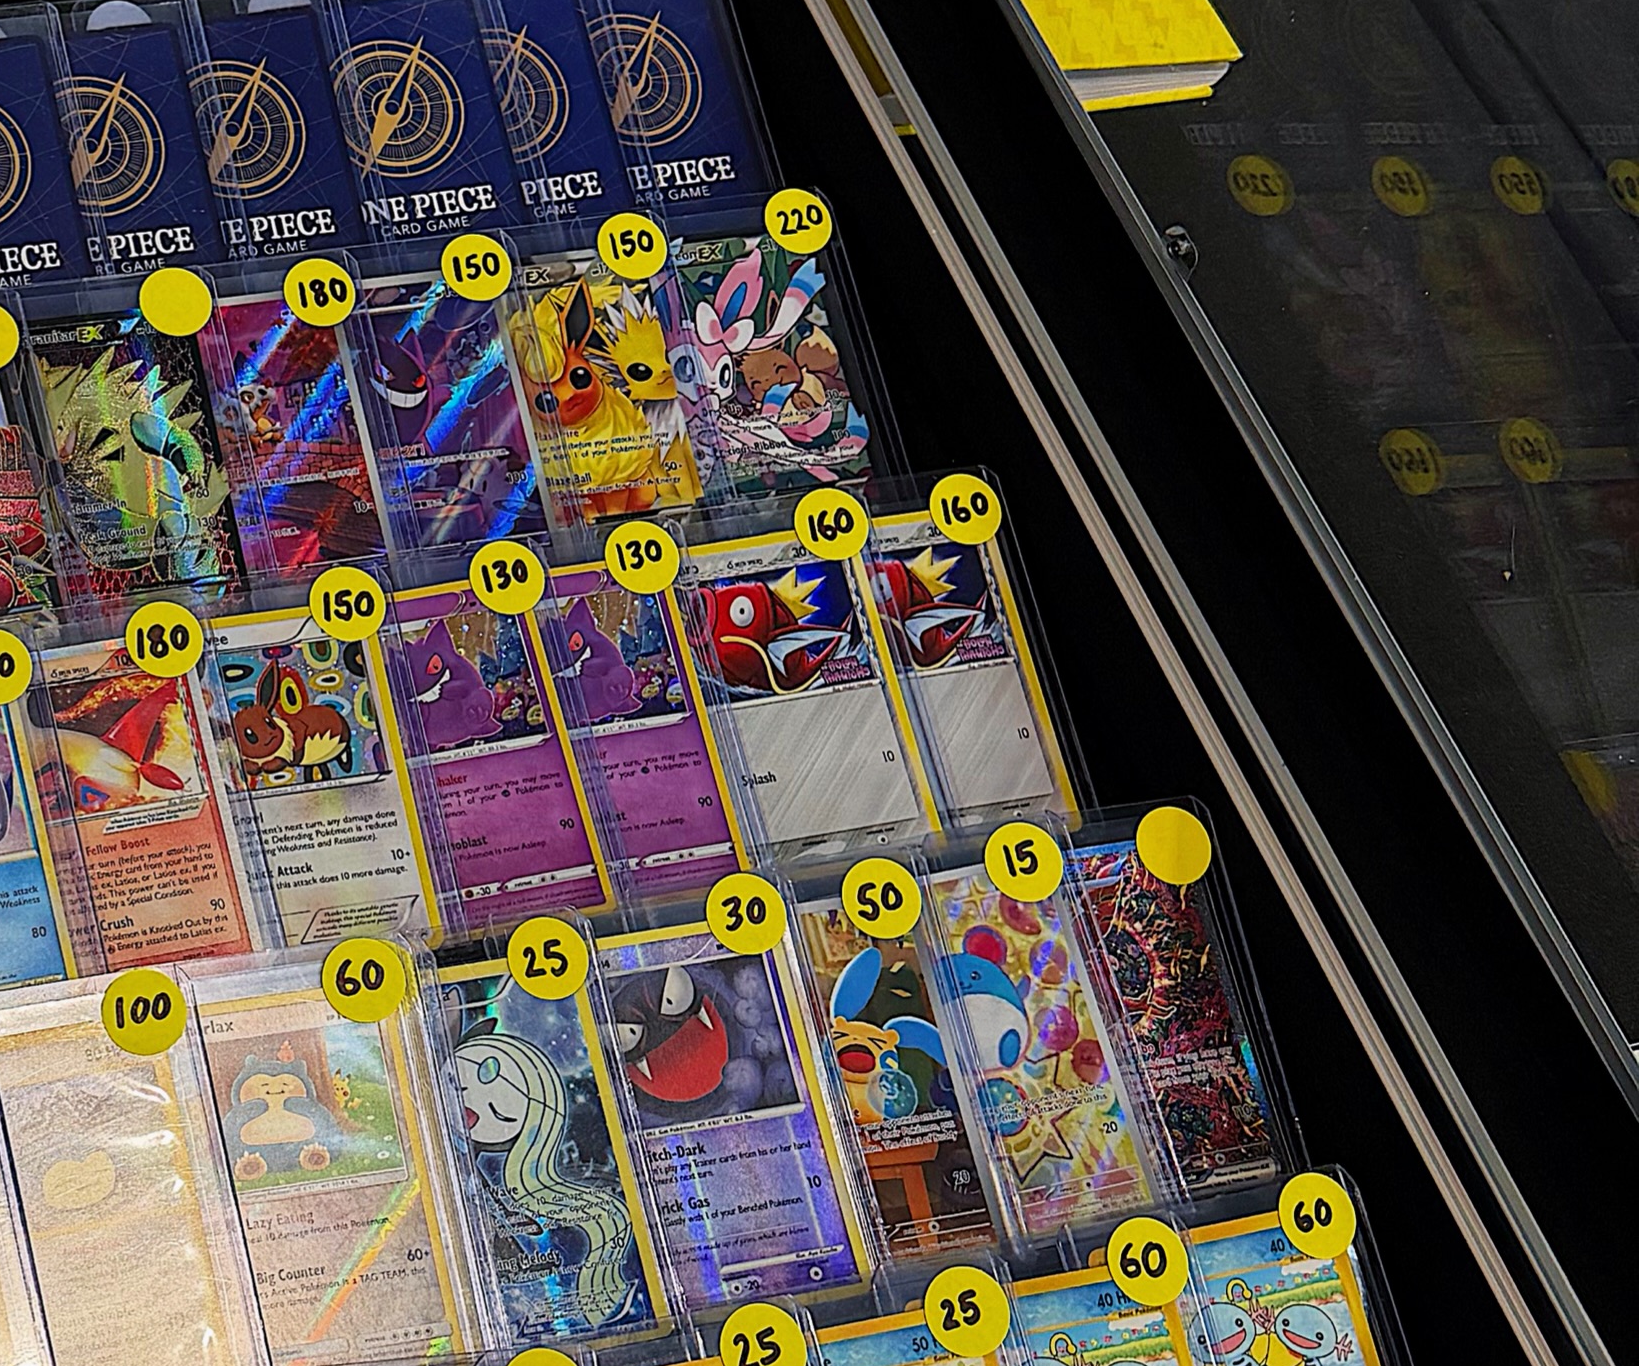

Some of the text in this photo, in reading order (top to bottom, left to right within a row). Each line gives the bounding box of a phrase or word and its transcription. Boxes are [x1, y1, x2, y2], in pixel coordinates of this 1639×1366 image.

[522, 171, 602, 205] PIECE
[653, 157, 736, 193] PIECE
[416, 185, 496, 222] PIECE
[777, 206, 823, 234] 220
[249, 209, 335, 244] PIECE
[112, 227, 194, 264] PIECE
[609, 231, 653, 258] 150
[453, 253, 499, 282] 150
[299, 278, 346, 307] 180
[809, 511, 853, 540] 160
[942, 493, 988, 525] 160
[616, 541, 662, 570] 130
[482, 561, 528, 593] 130
[324, 591, 374, 620] 150
[137, 626, 188, 659] 180
[277, 862, 313, 878] Attack
[1004, 840, 1038, 877] 15
[722, 897, 767, 930] 30
[858, 882, 902, 920] 50
[100, 915, 134, 931] Crush
[523, 940, 568, 977] 25
[336, 960, 384, 996] 60
[116, 992, 171, 1028] 100
[1294, 1198, 1333, 1232] 60
[1119, 1242, 1167, 1278] 60
[940, 1290, 981, 1331] 25
